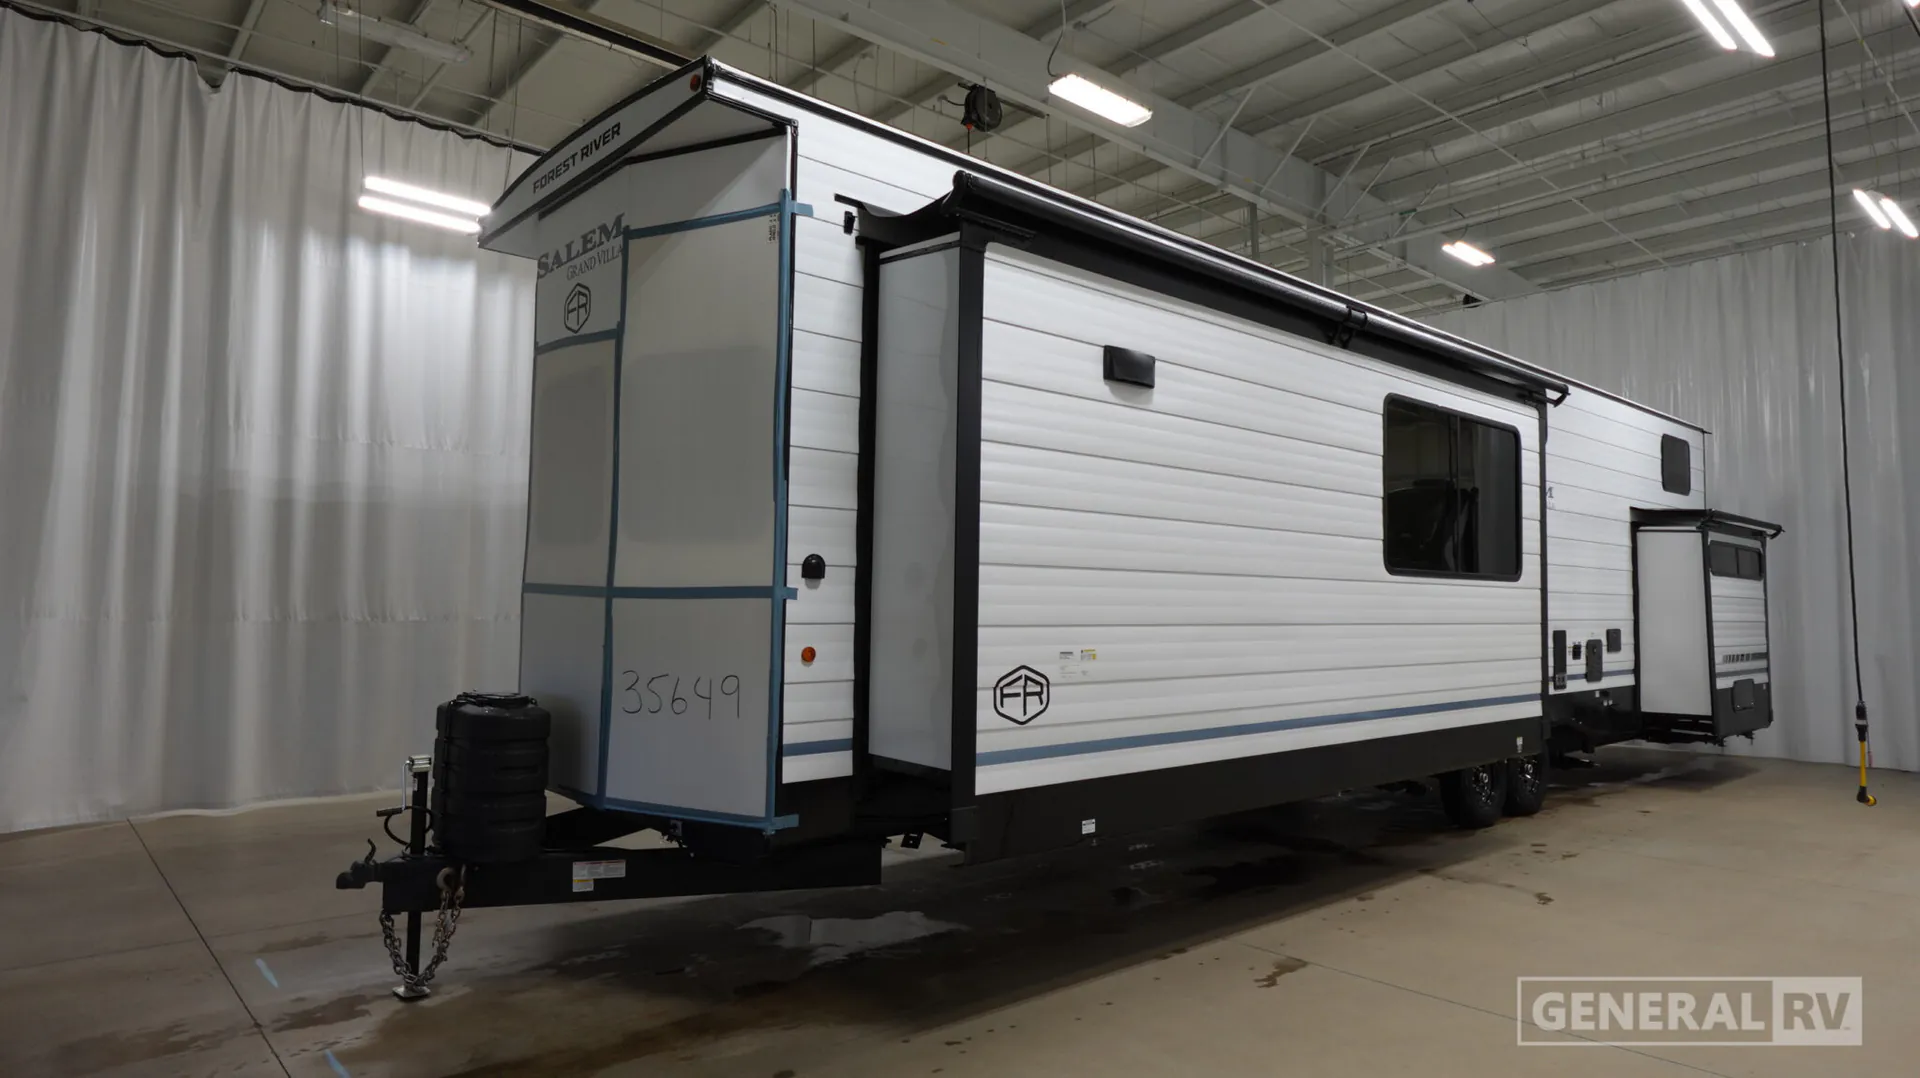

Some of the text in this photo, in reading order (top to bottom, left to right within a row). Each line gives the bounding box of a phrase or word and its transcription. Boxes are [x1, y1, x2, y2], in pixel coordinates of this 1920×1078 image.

[533, 122, 621, 194] FOREST RIVER
[538, 212, 625, 279] SALEM
[566, 257, 598, 281] GRAND
[622, 669, 740, 720] 35649
